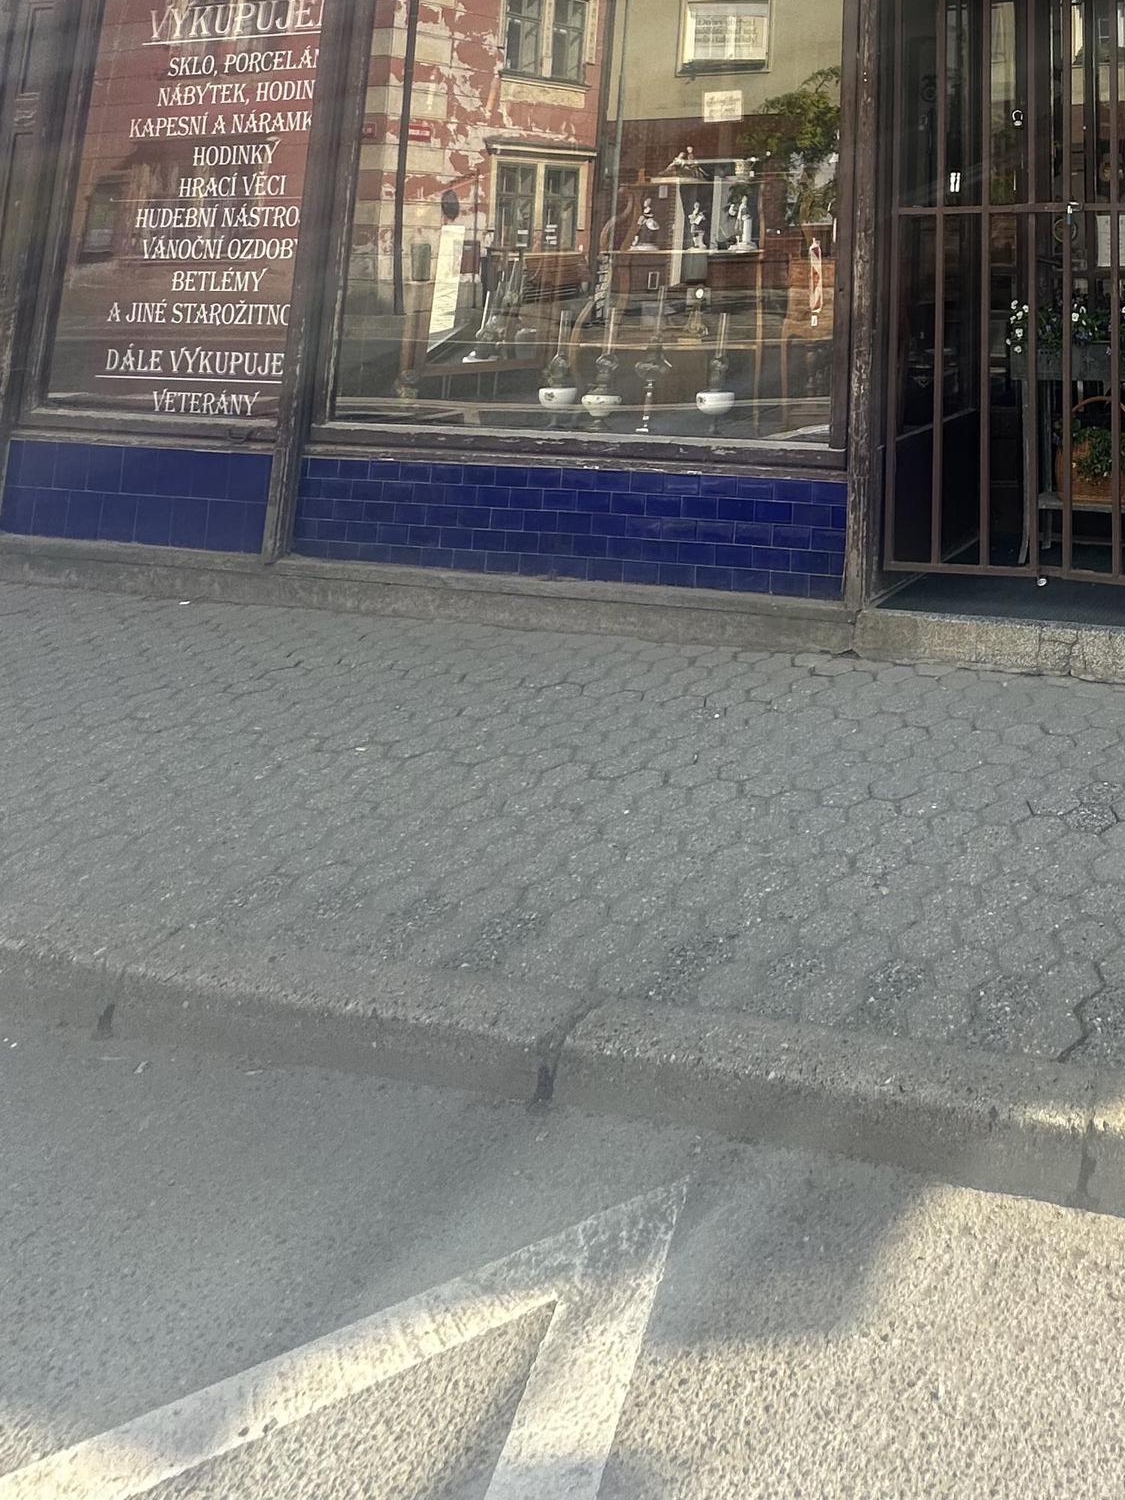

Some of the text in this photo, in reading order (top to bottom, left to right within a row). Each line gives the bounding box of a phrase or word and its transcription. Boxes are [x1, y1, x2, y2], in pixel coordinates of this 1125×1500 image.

[168, 55, 218, 77] SKLO,
[157, 81, 250, 106] NÁBYTEK,
[129, 112, 208, 138] KAPESNÍ
[211, 115, 226, 134] A
[193, 140, 280, 166] HODINKY
[179, 171, 287, 198] HRACÍ VĚCI
[135, 203, 301, 229] HUDEBNÍ NÁSTRO
[142, 236, 298, 260] VÁNOČNÍ OZDOB
[171, 267, 269, 292] BETLÉMY
[107, 302, 121, 323] A
[126, 299, 168, 324] JINÉ
[105, 344, 285, 376] DÁLE VYKUPUJE
[153, 388, 261, 416] VETERÁNY
